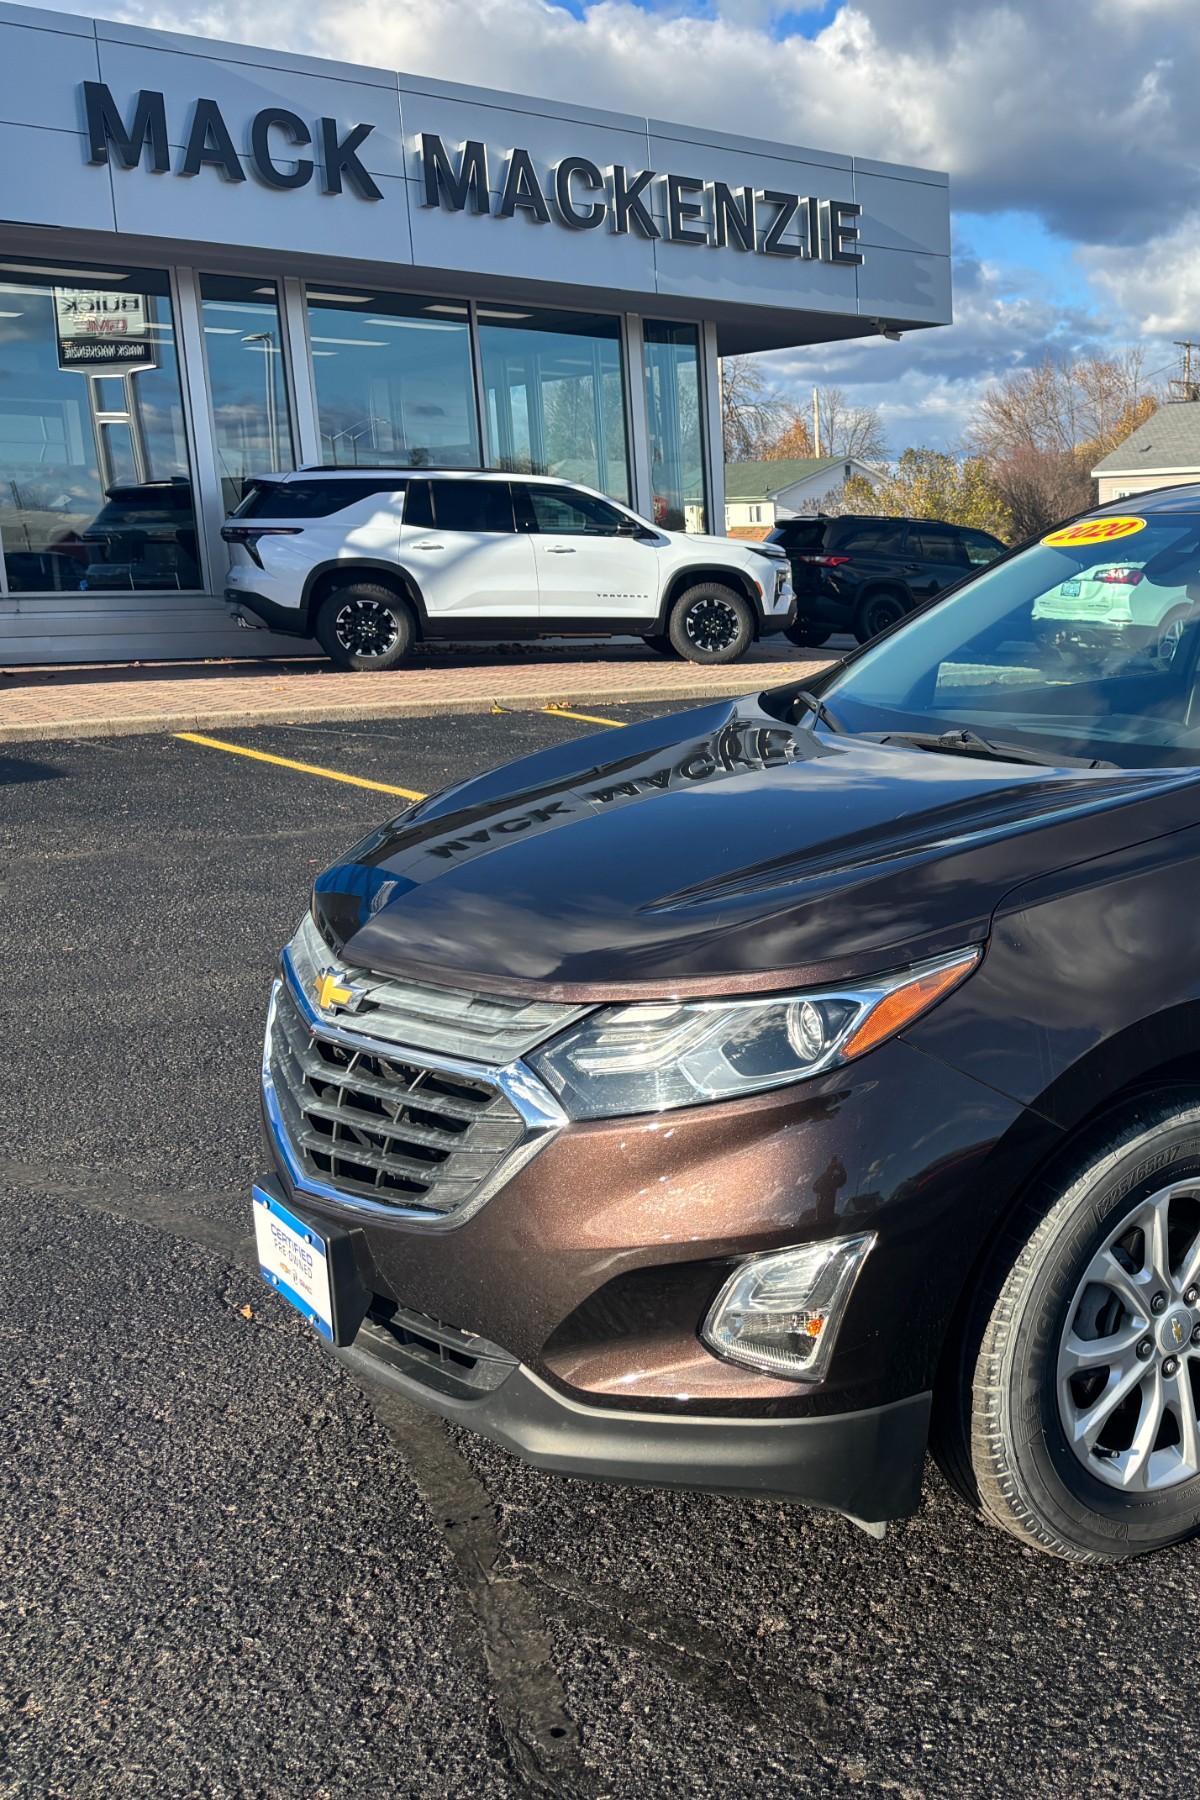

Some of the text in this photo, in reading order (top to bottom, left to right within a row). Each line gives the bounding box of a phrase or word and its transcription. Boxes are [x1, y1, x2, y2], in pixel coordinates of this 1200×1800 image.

[80, 80, 865, 265] MACK MACKENZIE
[1047, 521, 1139, 542] 2020
[270, 1223, 313, 1267] CERTIFIED
[273, 1238, 313, 1279] PRE-OWNED
